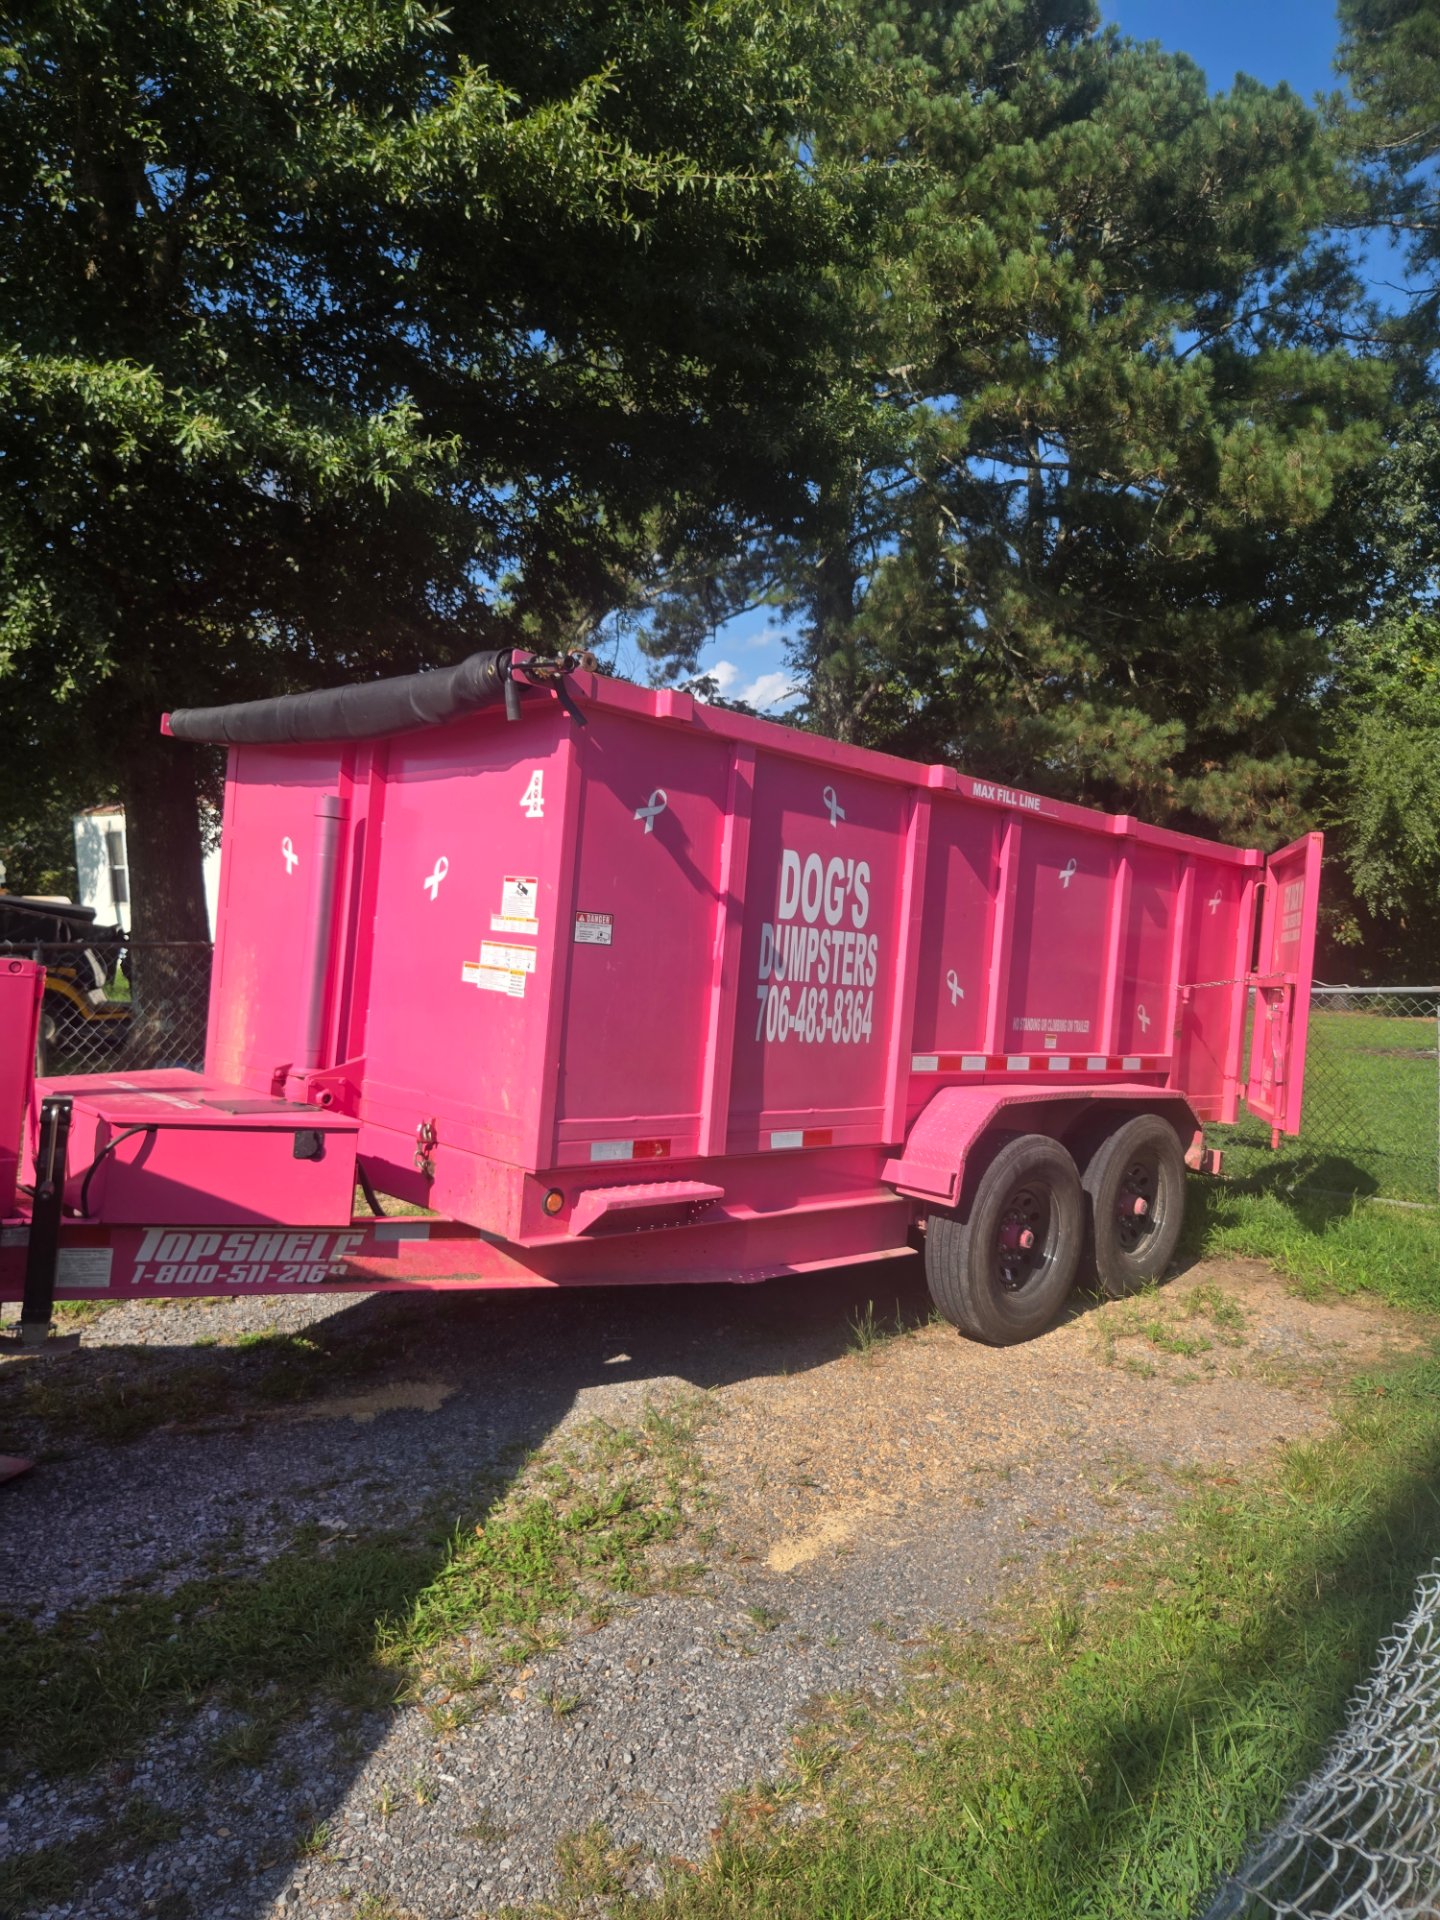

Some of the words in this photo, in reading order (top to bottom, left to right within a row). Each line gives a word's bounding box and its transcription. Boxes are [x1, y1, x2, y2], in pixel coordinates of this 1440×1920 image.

[520, 769, 545, 818] 4
[972, 782, 995, 801] MAX
[997, 788, 1017, 806] FILL
[1019, 794, 1041, 811] LINE
[778, 849, 871, 929] DOG'S
[758, 922, 878, 987] DUMPSTERS
[755, 984, 874, 1044] 706-483-8364
